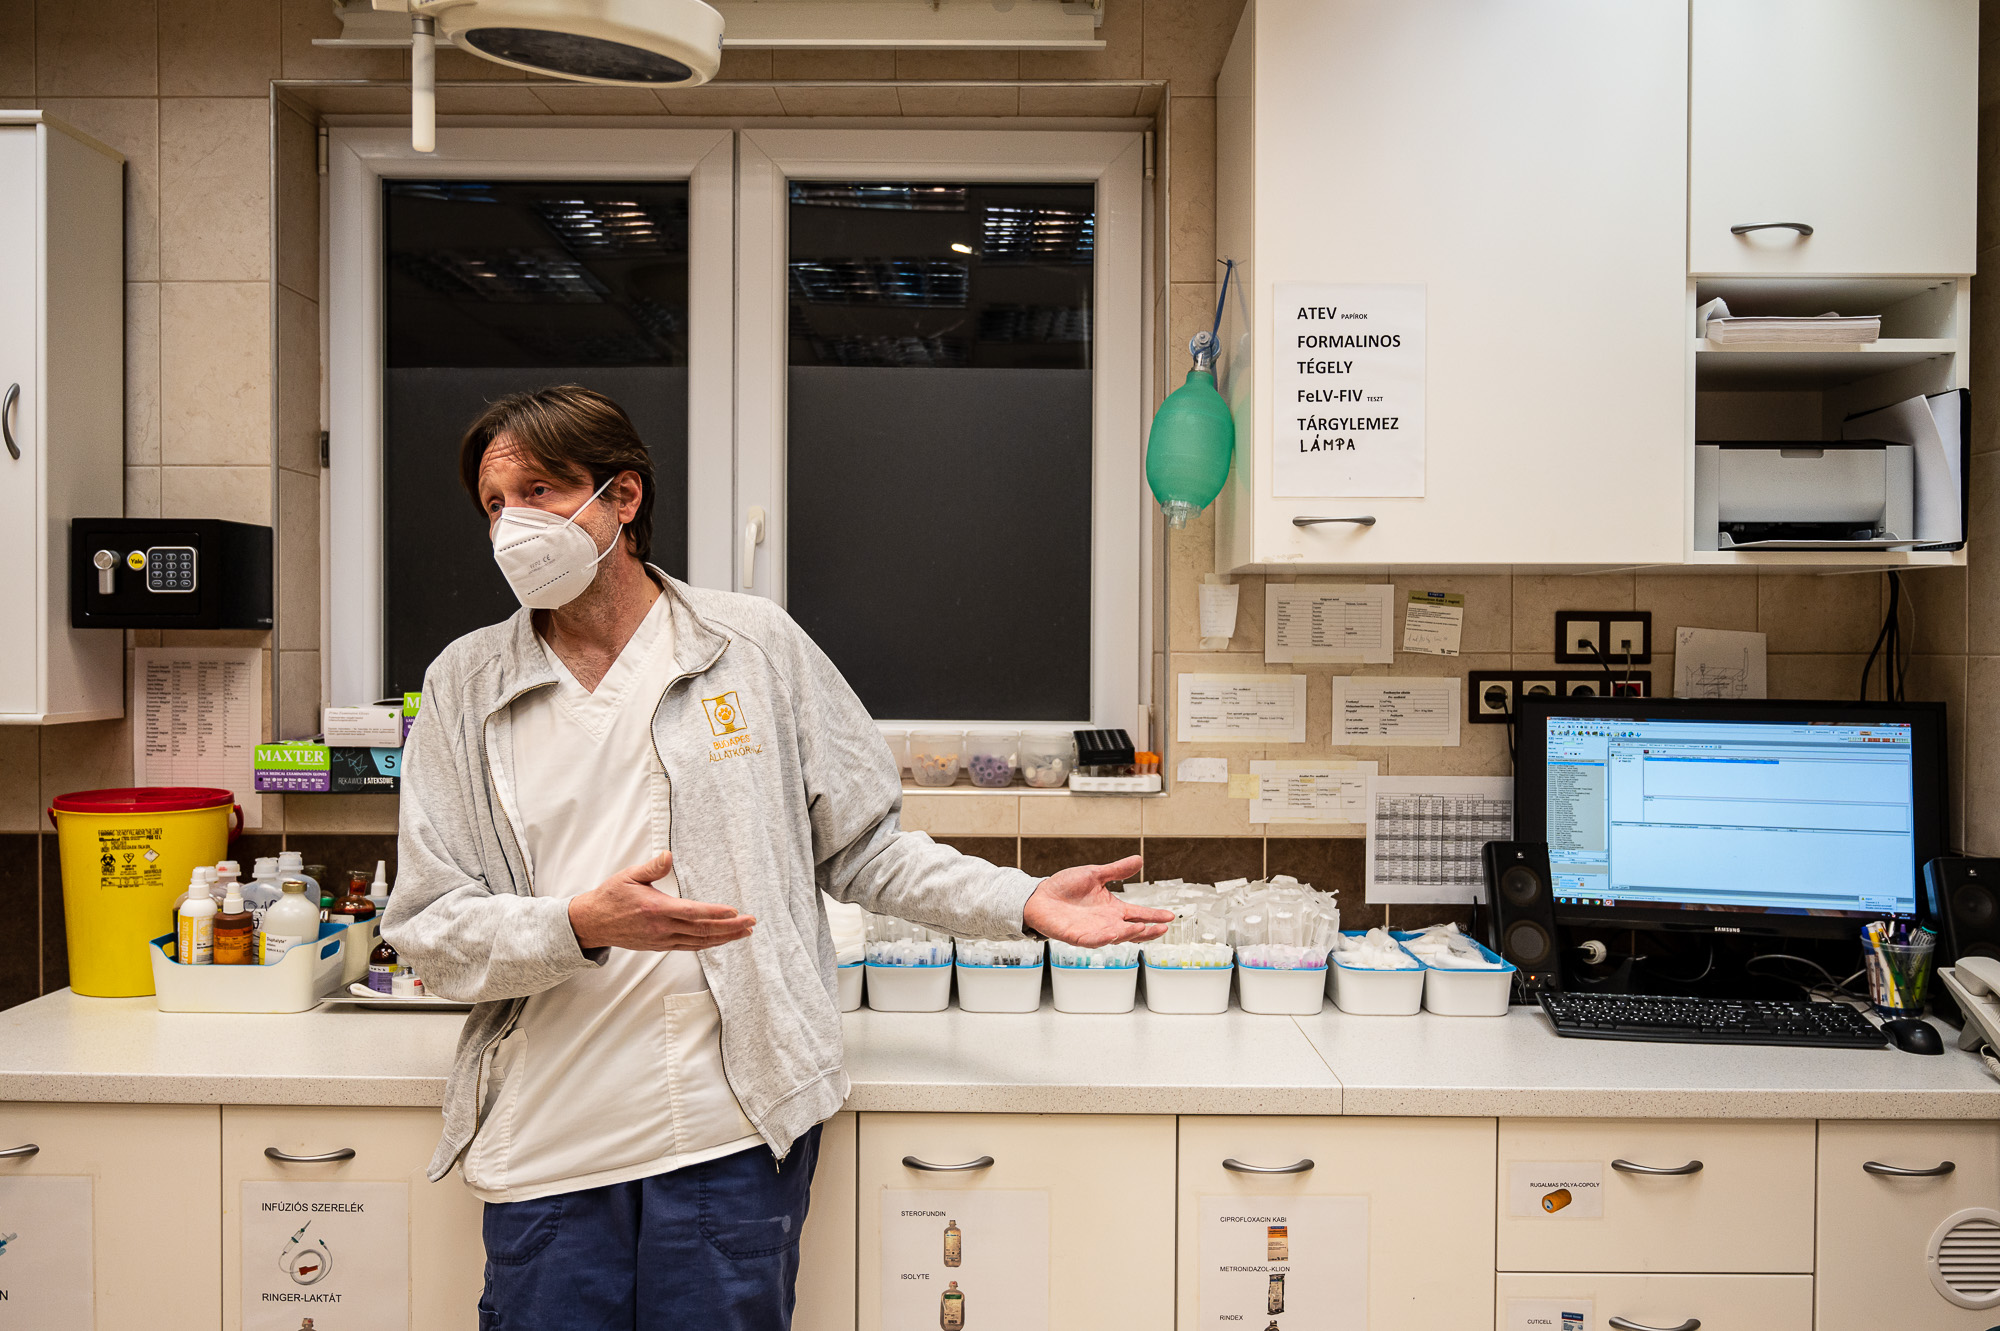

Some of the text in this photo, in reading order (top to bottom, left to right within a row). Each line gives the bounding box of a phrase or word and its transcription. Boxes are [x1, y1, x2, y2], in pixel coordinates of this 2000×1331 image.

[1296, 306, 1368, 320] ATEV PAPÍROK
[1297, 334, 1401, 349] FORMALINOS
[1296, 357, 1353, 375] TÉGELY
[1297, 389, 1364, 403] FeLV-FIV
[1296, 414, 1399, 431] TÁRGYLEMEZ
[1299, 433, 1356, 453] LÁMPA
[130, 558, 144, 566] Yale
[257, 749, 325, 763] MAXTER
[384, 755, 396, 769] S
[261, 1201, 364, 1213] INFÚZIÓS SZERELÉK
[261, 1293, 342, 1303] RINGER-LAKTÁT
